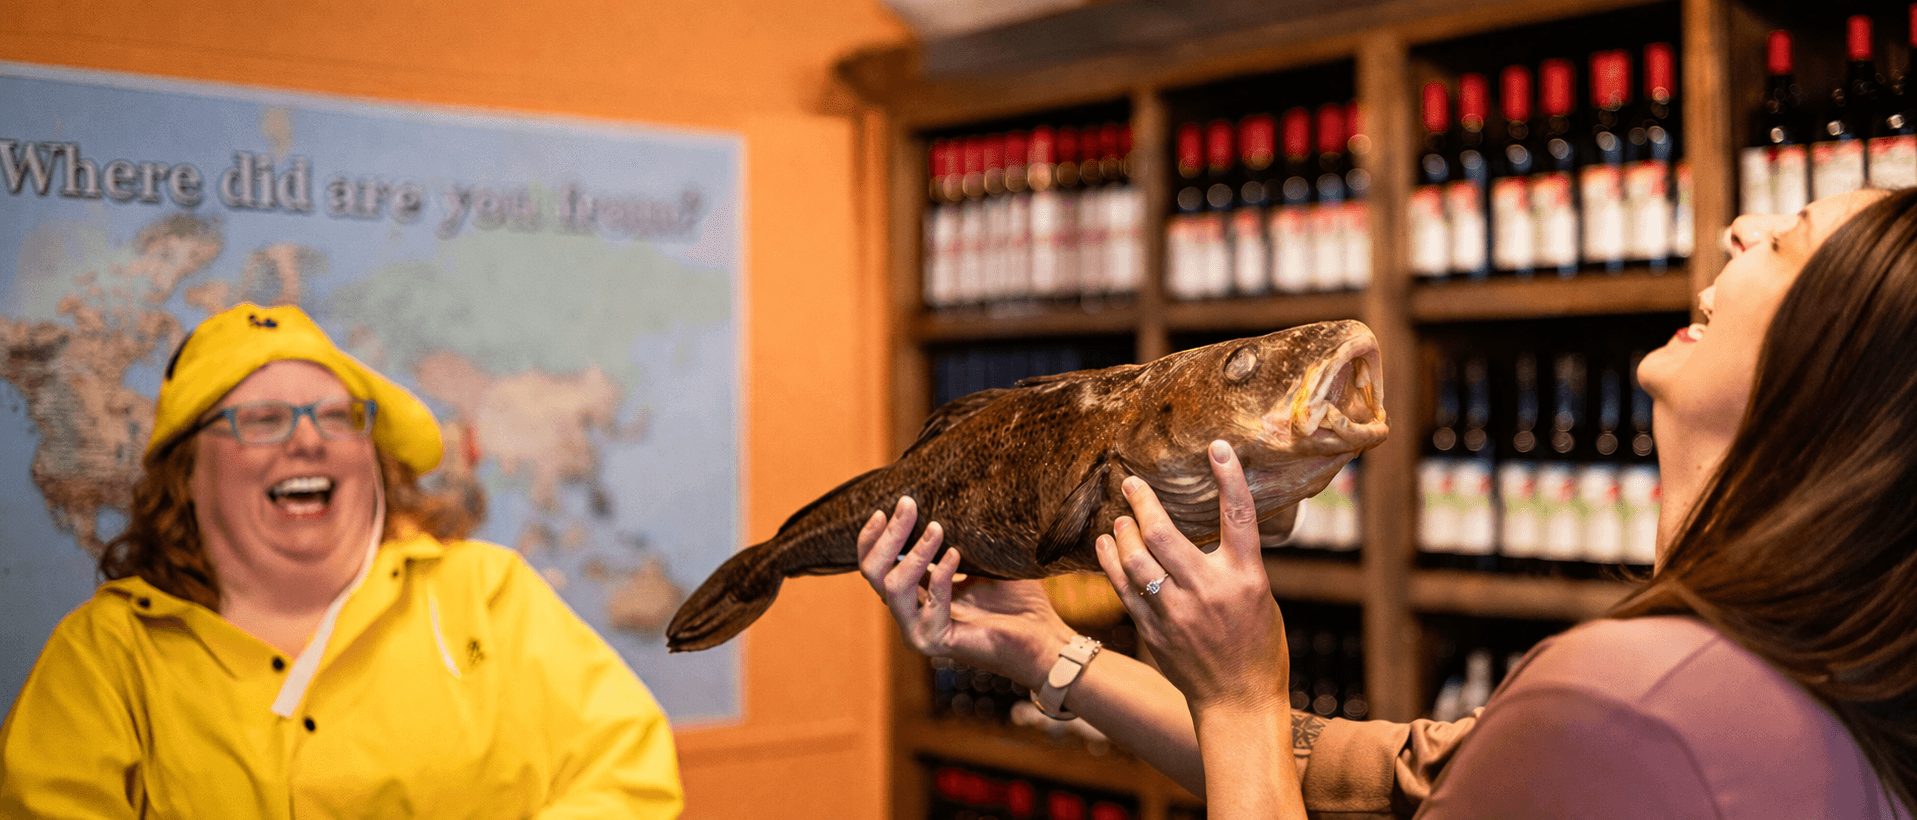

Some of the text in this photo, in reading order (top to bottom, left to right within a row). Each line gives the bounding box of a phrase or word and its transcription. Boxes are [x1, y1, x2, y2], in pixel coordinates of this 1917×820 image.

[0, 138, 203, 208] Where
[221, 150, 313, 213] did
[327, 172, 426, 222] are
[435, 181, 538, 240] you
